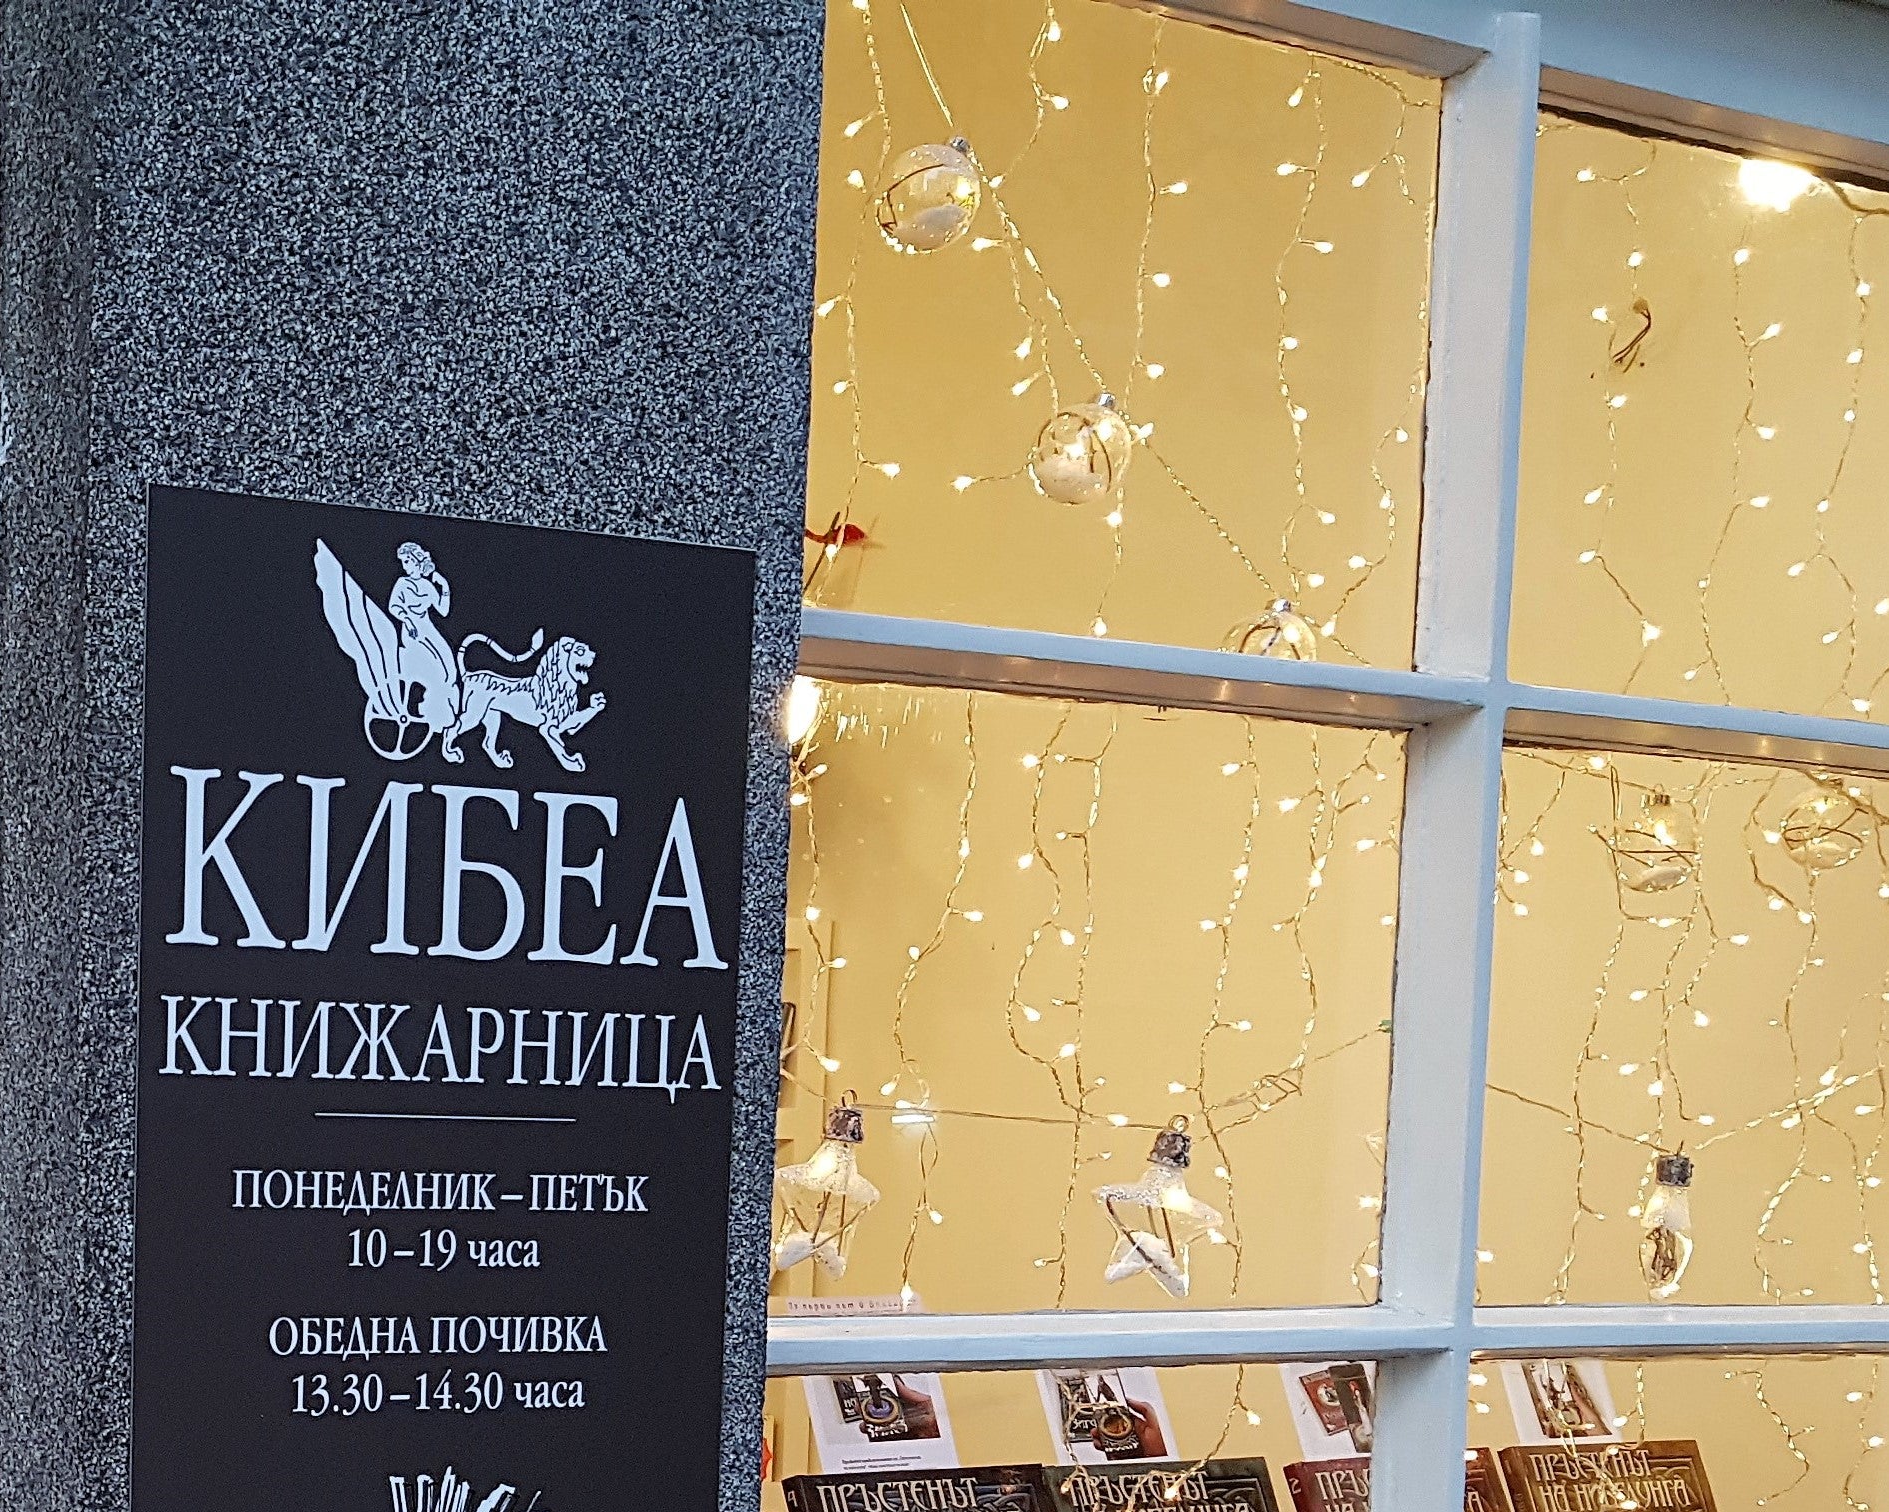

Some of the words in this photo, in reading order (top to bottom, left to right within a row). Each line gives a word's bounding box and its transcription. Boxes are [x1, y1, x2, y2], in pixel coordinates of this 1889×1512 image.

[166, 765, 729, 971] КИБЕА
[158, 993, 722, 1104] КНИЖАРНИЦА
[467, 1236, 541, 1269] часа
[268, 1315, 417, 1361] ОБЕДНА
[429, 1315, 608, 1355] ПОЧИВКА
[513, 1378, 586, 1410] часа
[1537, 1479, 1570, 1512] НА
